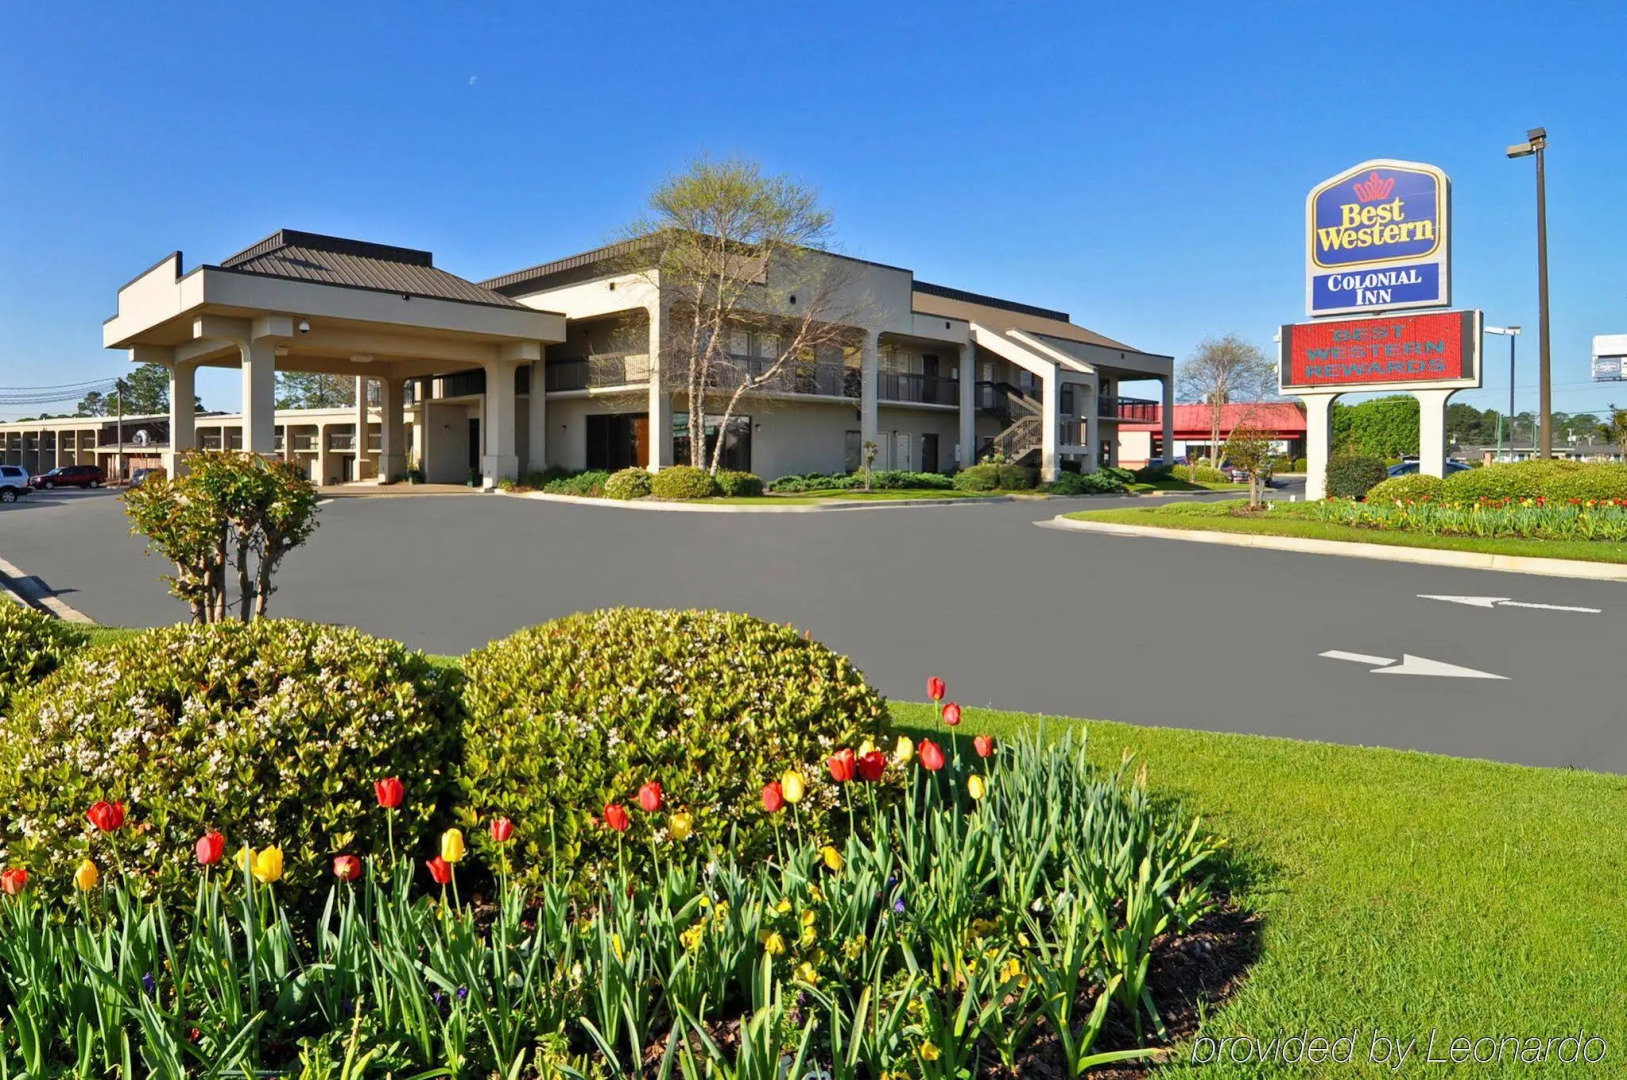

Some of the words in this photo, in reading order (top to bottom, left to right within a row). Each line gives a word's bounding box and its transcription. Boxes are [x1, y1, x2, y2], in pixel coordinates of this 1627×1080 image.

[1340, 197, 1404, 228] Best
[1318, 219, 1434, 252] Western
[1327, 269, 1422, 291] COLONIAL
[1355, 288, 1392, 305] INN
[1333, 325, 1406, 342] BEST
[1307, 340, 1445, 361] WESTERN
[1305, 358, 1446, 378] REWARDS
